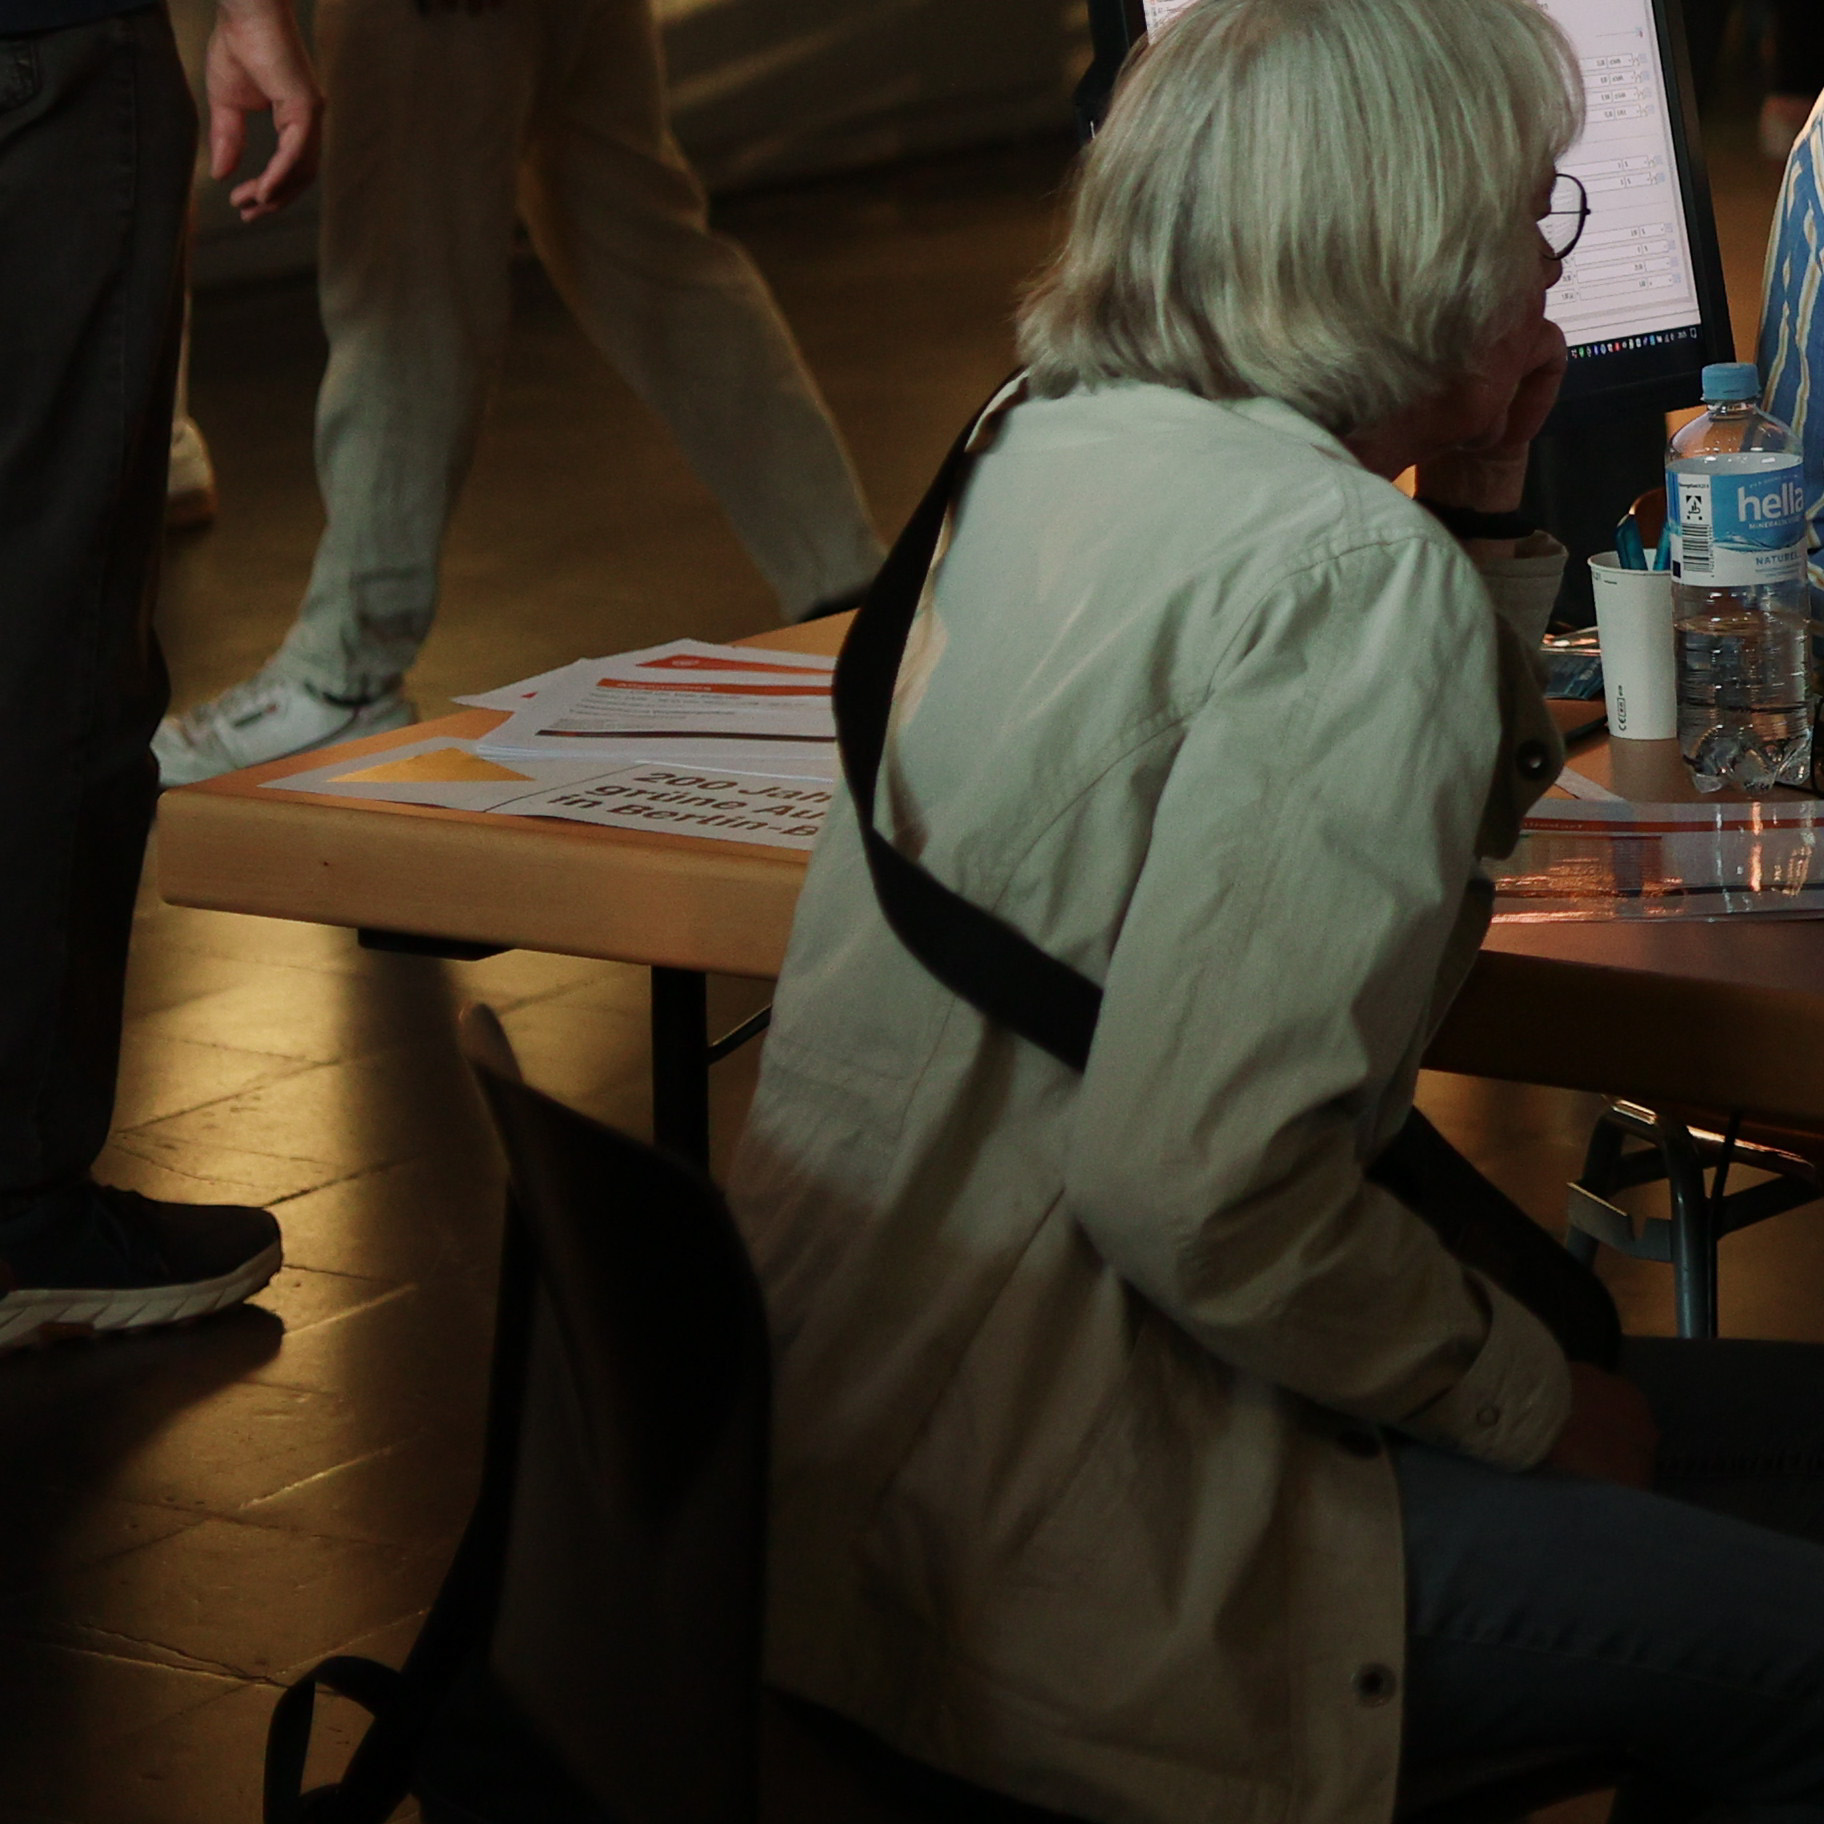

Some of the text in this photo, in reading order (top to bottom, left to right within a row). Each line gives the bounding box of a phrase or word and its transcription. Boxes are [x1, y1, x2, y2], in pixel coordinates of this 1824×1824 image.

[1737, 481, 1804, 523] hella
[585, 784, 747, 811] grüne
[633, 772, 738, 790] 200
[546, 793, 819, 838] in Berlin-B
